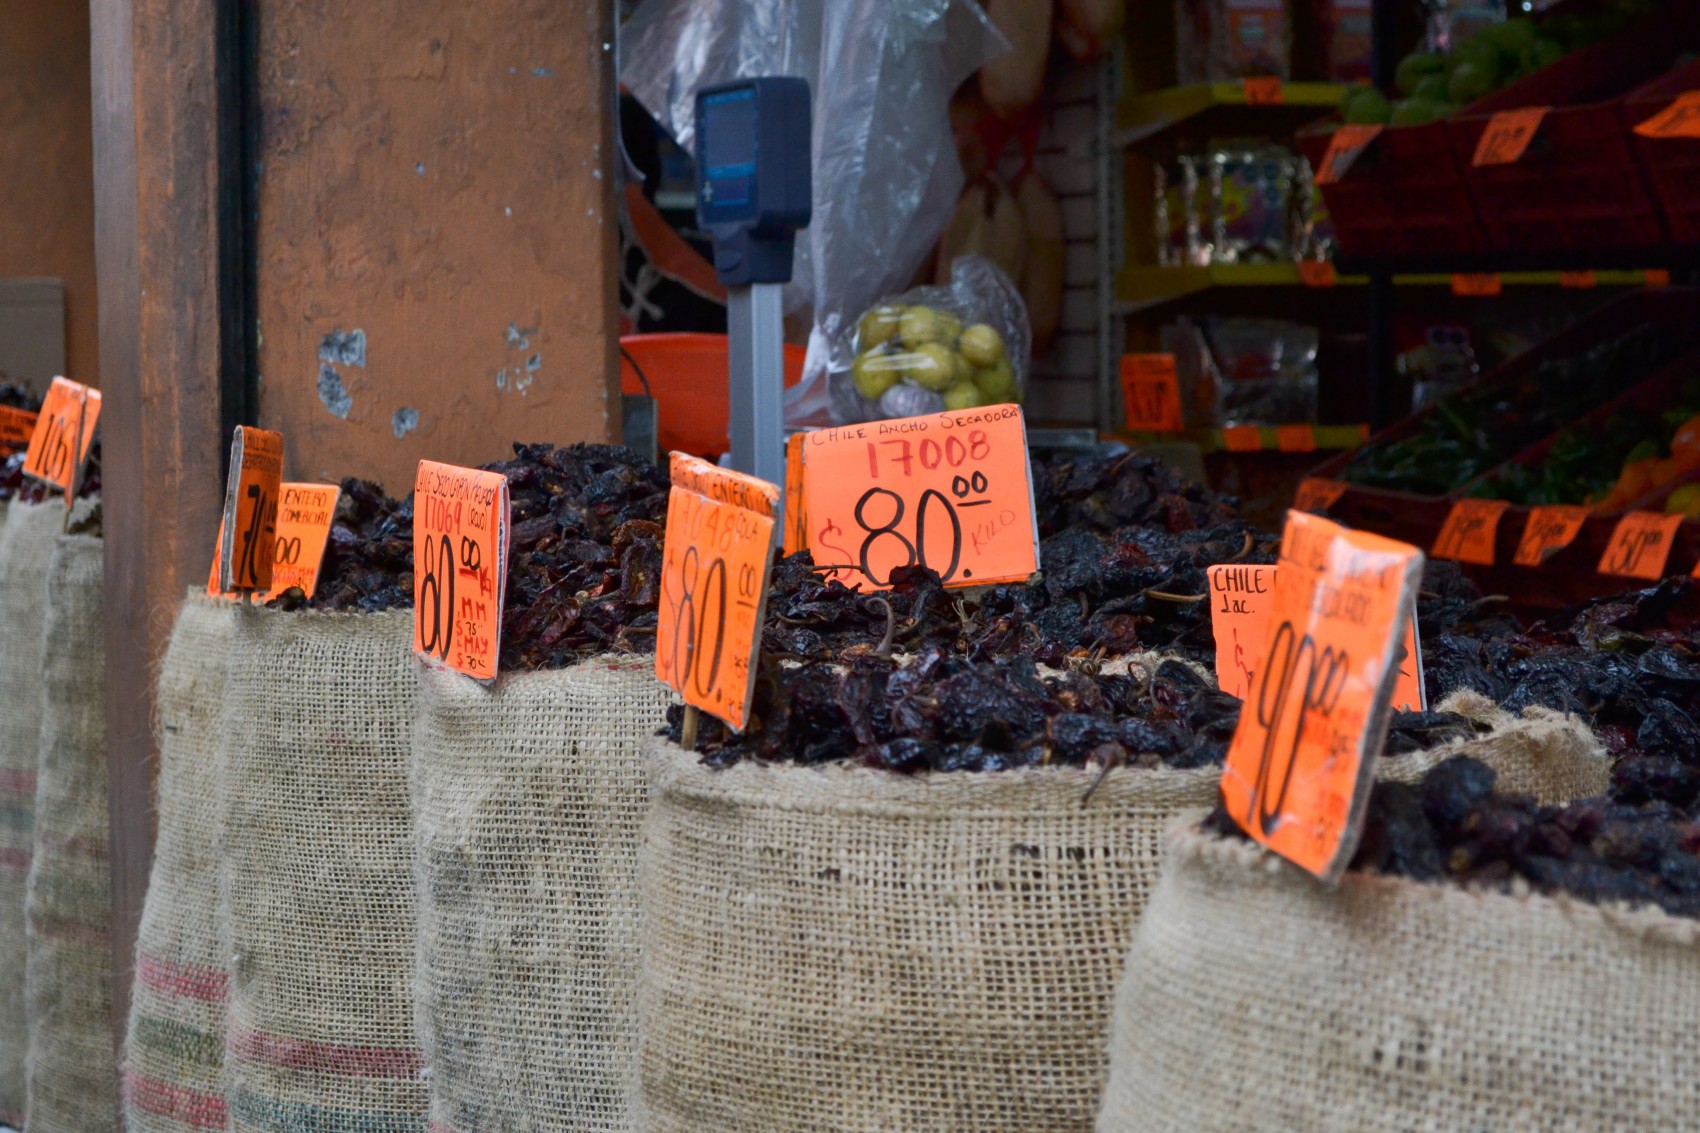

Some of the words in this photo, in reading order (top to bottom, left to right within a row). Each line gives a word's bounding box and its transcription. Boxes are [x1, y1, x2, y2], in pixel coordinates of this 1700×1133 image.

[812, 429, 868, 447] CHILE
[879, 421, 928, 436] ANCHO
[940, 409, 1019, 430] SECADORA
[867, 429, 991, 479] 17008
[284, 489, 328, 507] ENTERO
[282, 508, 329, 526] COMERCIAL
[1214, 567, 1267, 593] CHILE
